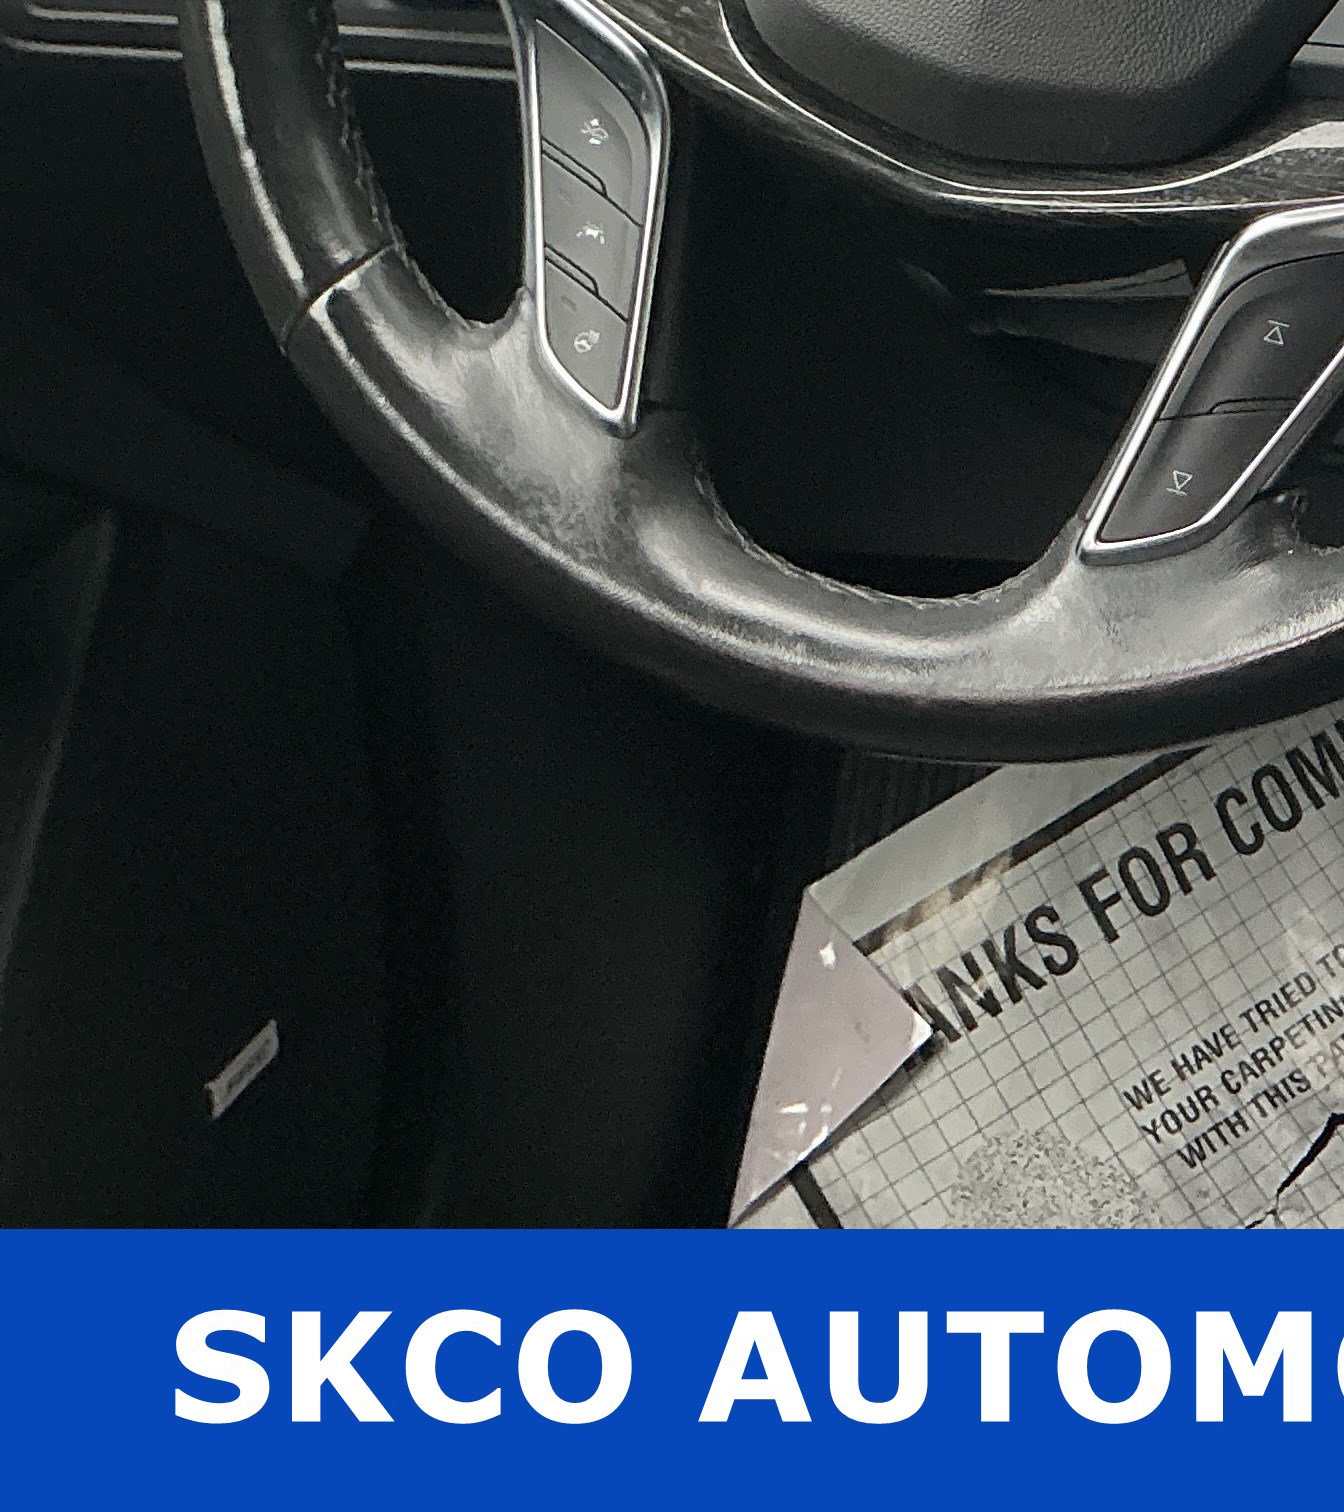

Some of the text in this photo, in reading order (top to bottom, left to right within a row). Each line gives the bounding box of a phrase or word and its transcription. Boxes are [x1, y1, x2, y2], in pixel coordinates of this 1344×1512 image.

[901, 905, 1080, 1043] ANKS
[1078, 822, 1217, 944] FOR
[1123, 1068, 1172, 1111] WE
[1170, 1023, 1242, 1081] HAVE
[1238, 971, 1316, 1034] TRIED
[1140, 1084, 1220, 1144] YOUR
[1175, 1109, 1250, 1169] WITH
[1248, 1066, 1312, 1118] THIS
